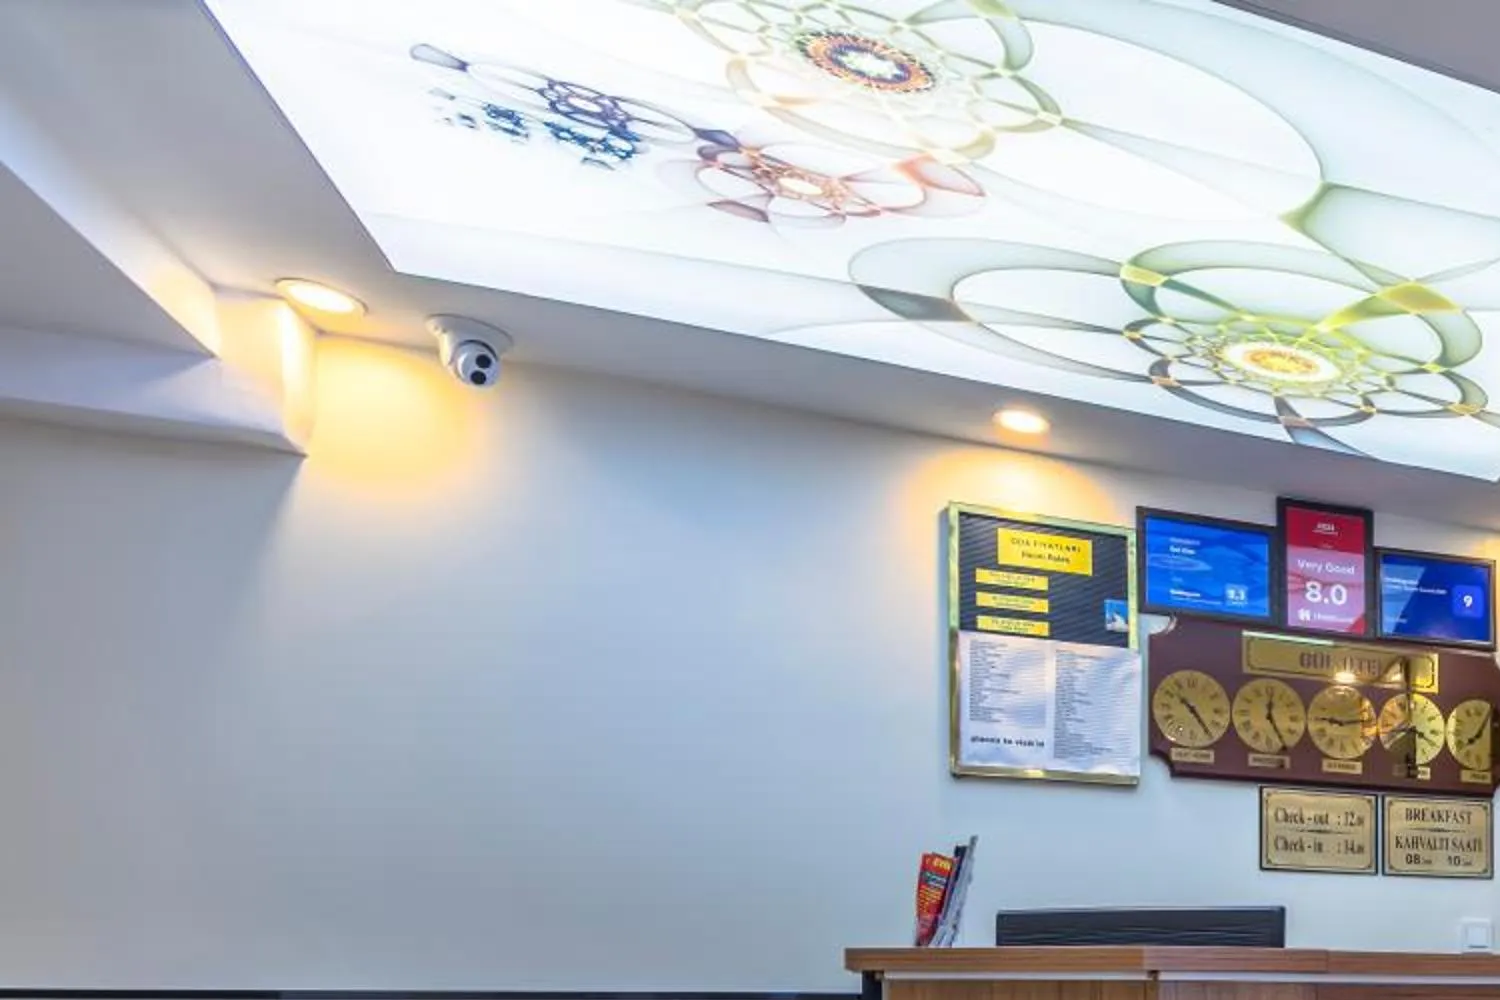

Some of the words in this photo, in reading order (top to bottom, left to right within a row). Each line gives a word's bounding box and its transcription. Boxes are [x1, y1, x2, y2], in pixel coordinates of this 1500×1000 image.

[1297, 559, 1323, 573] Very
[1325, 561, 1356, 576] Good
[1304, 580, 1348, 606] 8.0
[1463, 594, 1474, 608] 9
[1405, 807, 1472, 825] BREAKFAST
